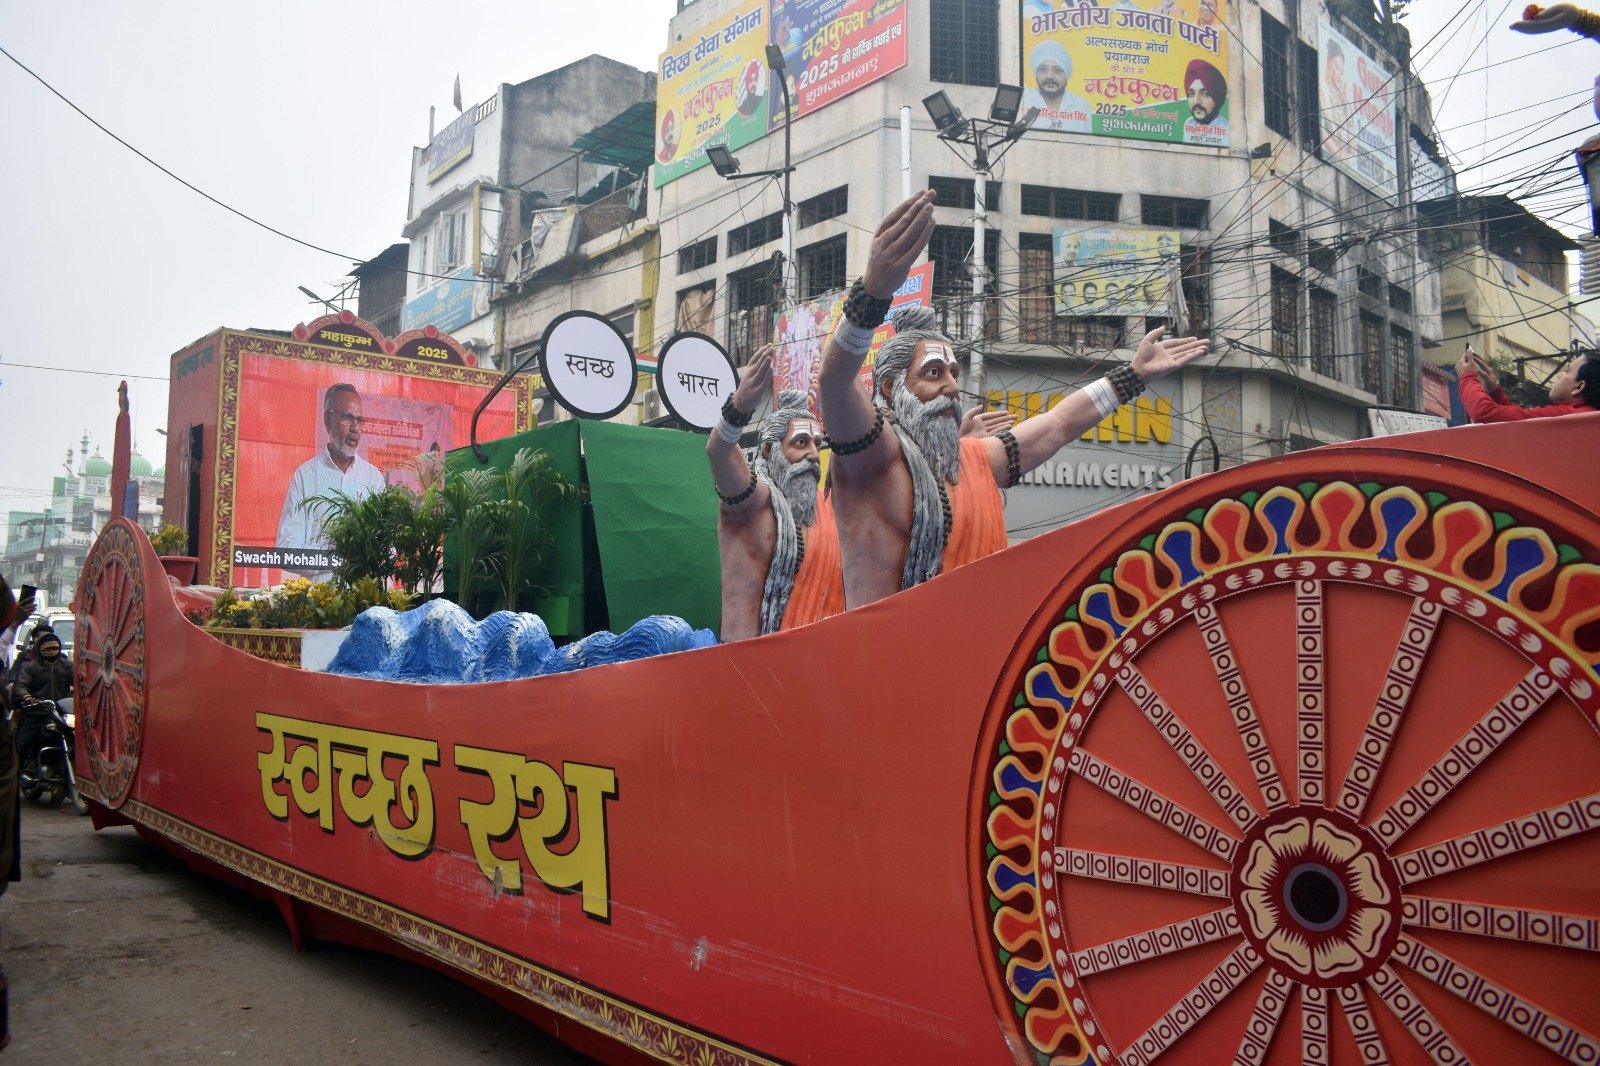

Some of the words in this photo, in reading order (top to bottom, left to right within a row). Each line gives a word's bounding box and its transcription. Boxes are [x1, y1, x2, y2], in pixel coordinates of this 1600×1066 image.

[801, 9, 865, 60] महाकुम्भ
[1031, 2, 1111, 34] भारतीय
[1115, 8, 1173, 36] जनता
[1177, 20, 1218, 54] पार्टी
[662, 54, 691, 81] सिख
[694, 35, 721, 62] सेवा
[723, 7, 763, 44] संगम
[1146, 39, 1168, 54] मोर्चा
[1104, 51, 1150, 65] प्रयागराज
[799, 53, 839, 91] 2025
[1084, 75, 1180, 104] महाकुम्भ
[1095, 102, 1127, 117] 2025
[696, 113, 721, 135] 2025
[1102, 119, 1173, 136] शुभकामनाएं
[320, 330, 372, 348] महाकुम्भ
[417, 345, 448, 360] 2025
[565, 353, 615, 378] स्वच्छ
[677, 371, 720, 397] भारत
[235, 550, 280, 565] Swachh
[283, 552, 328, 567] Mohalla
[255, 711, 440, 861] स्वच्छ
[454, 744, 619, 926] रथ
